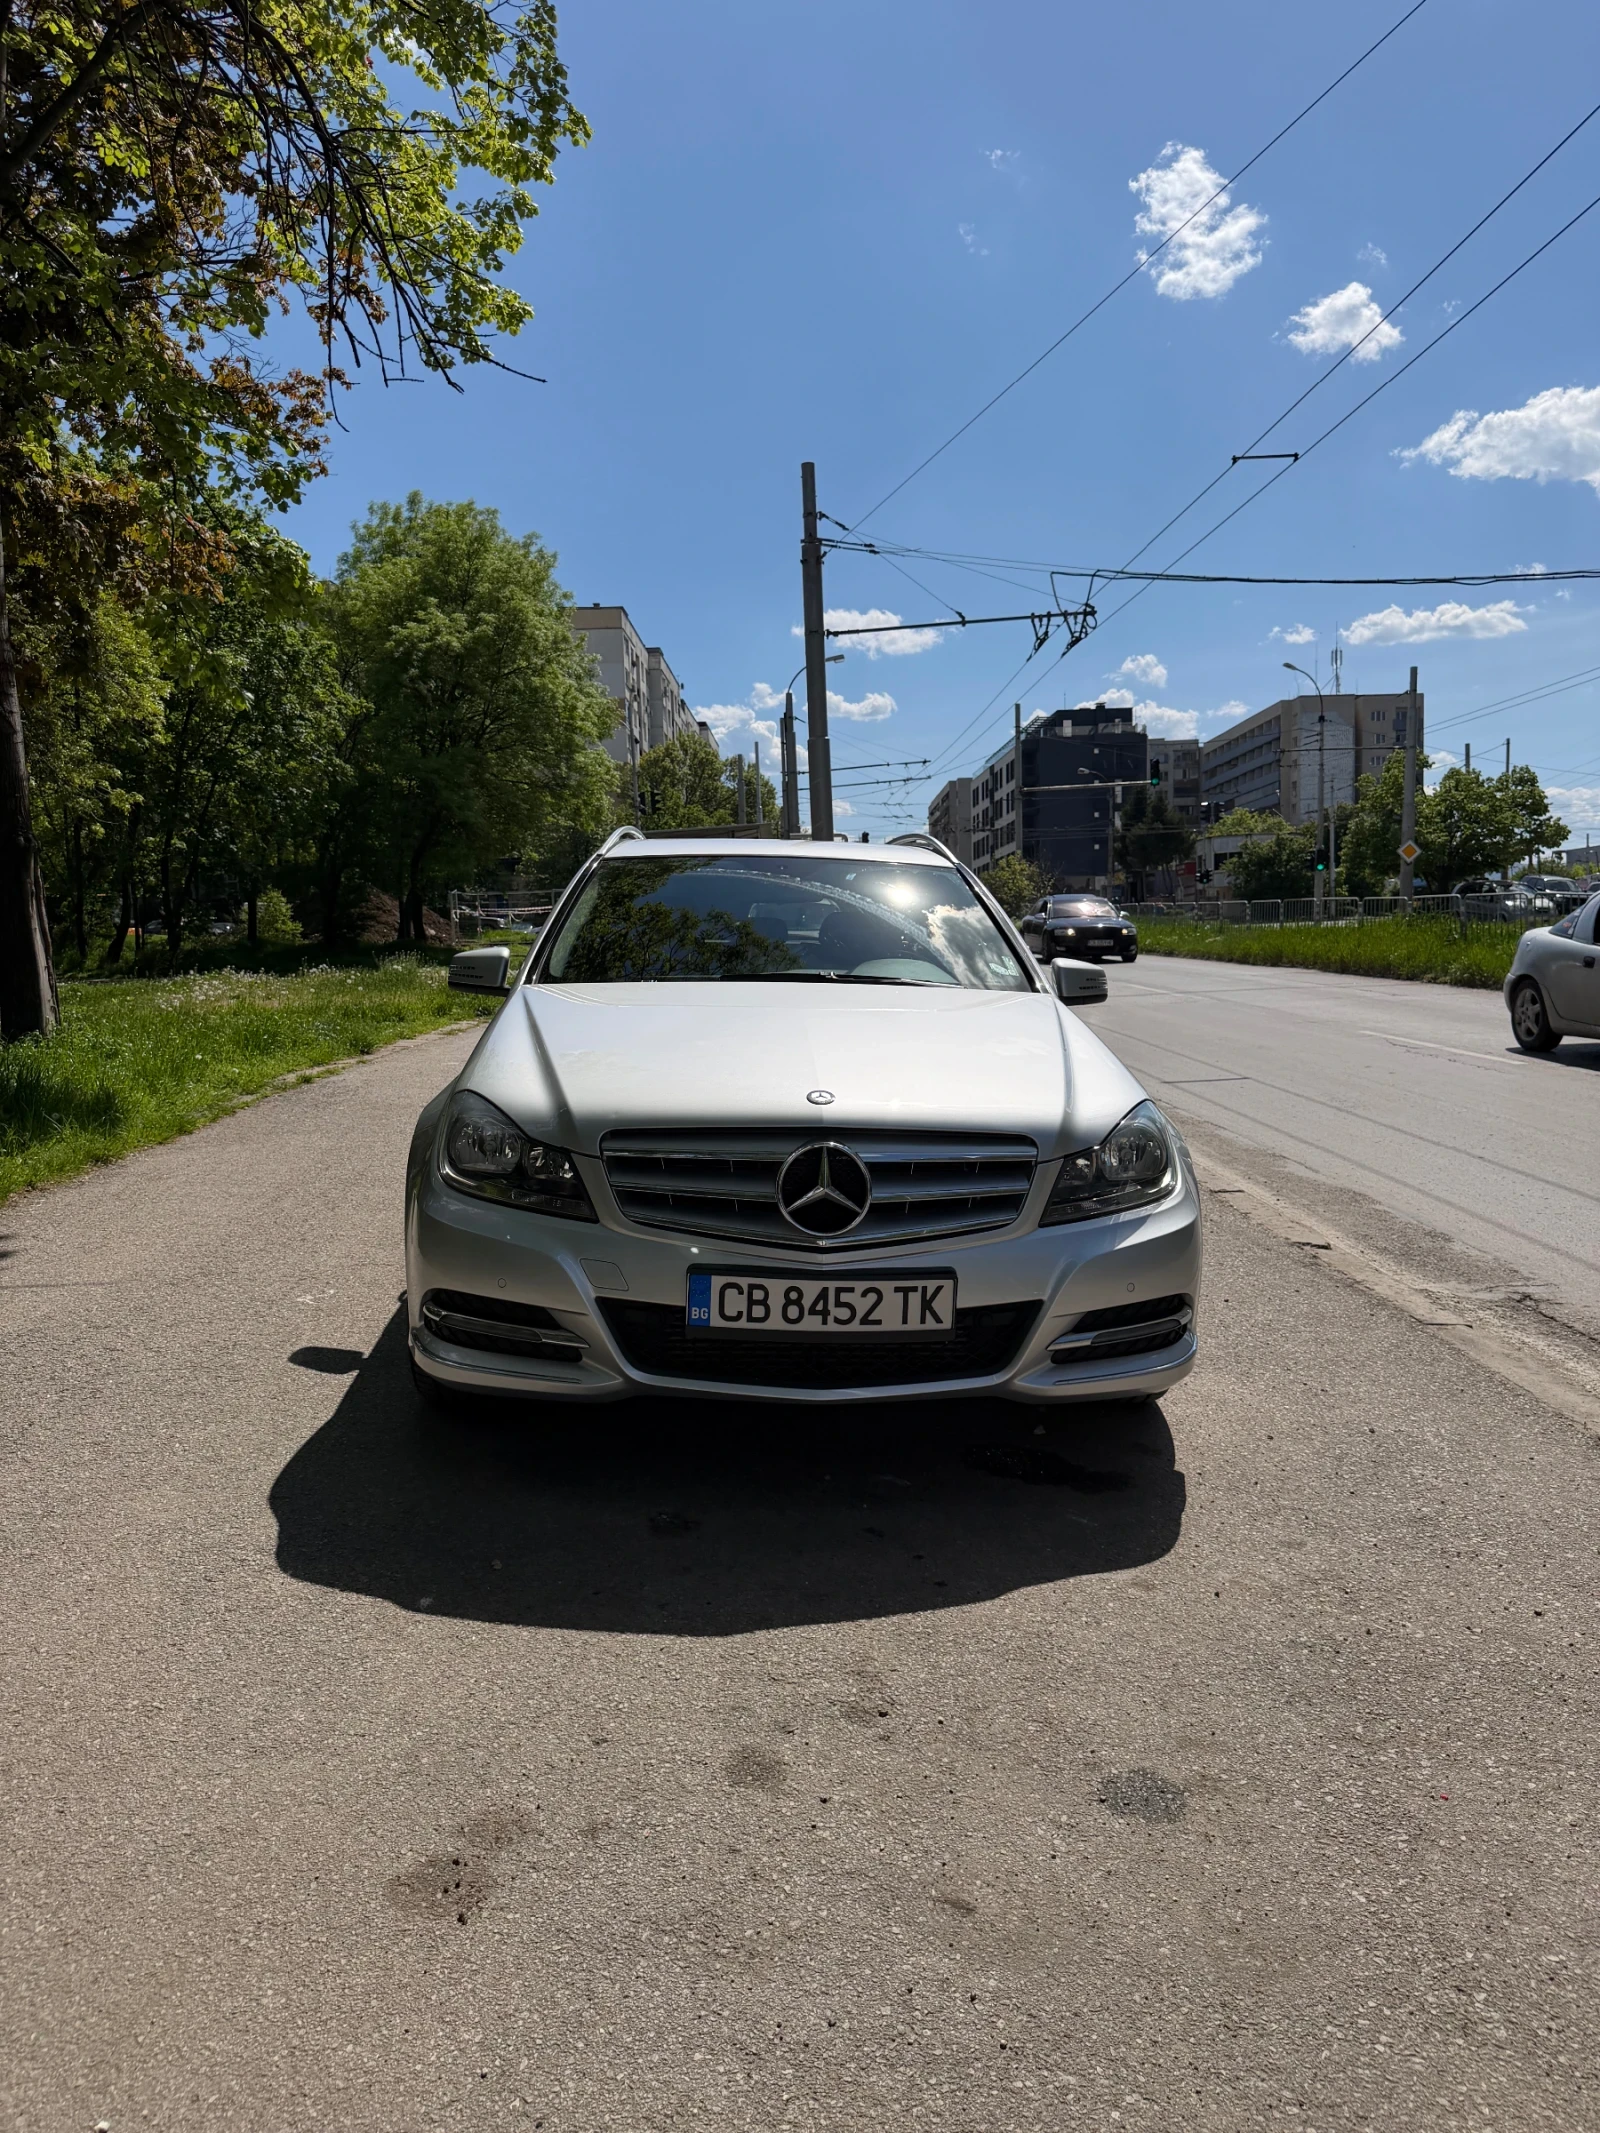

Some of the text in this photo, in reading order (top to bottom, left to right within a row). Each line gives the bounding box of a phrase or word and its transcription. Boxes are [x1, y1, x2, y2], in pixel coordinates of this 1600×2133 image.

[691, 1307, 708, 1319] BG
[718, 1282, 944, 1326] CB 8452 TK
